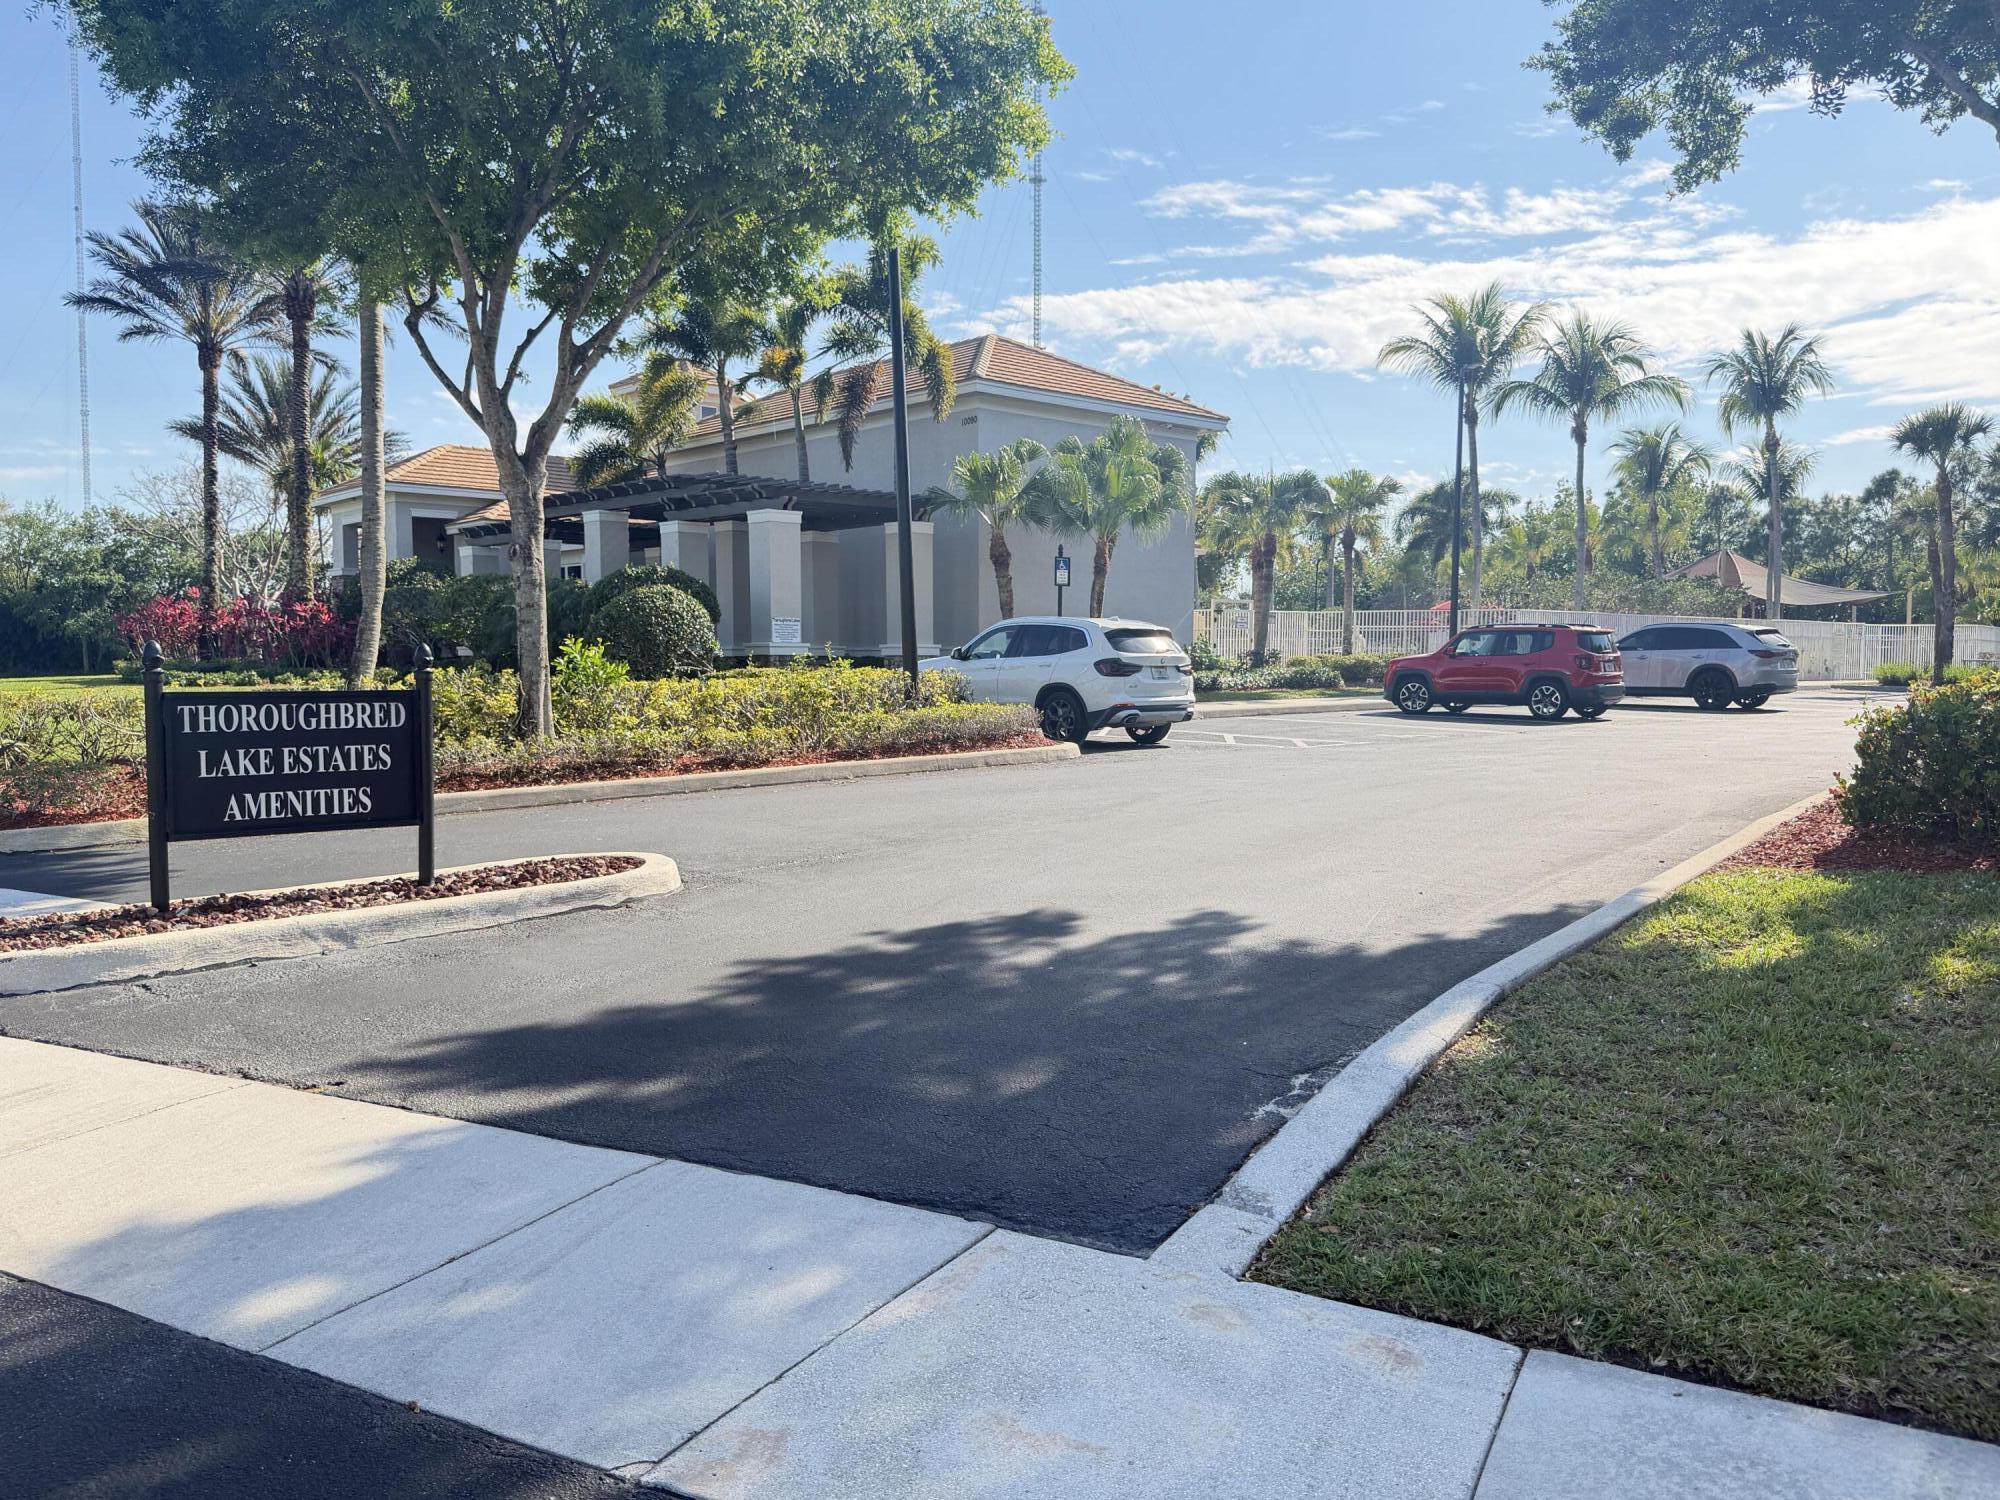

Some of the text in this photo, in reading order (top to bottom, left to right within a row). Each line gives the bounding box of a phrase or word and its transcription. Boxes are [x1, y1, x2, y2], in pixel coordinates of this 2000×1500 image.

[177, 702, 406, 733] THOROUGHBRED
[198, 744, 392, 778] LAKE ESTATES
[223, 787, 372, 822] AMENITIES
